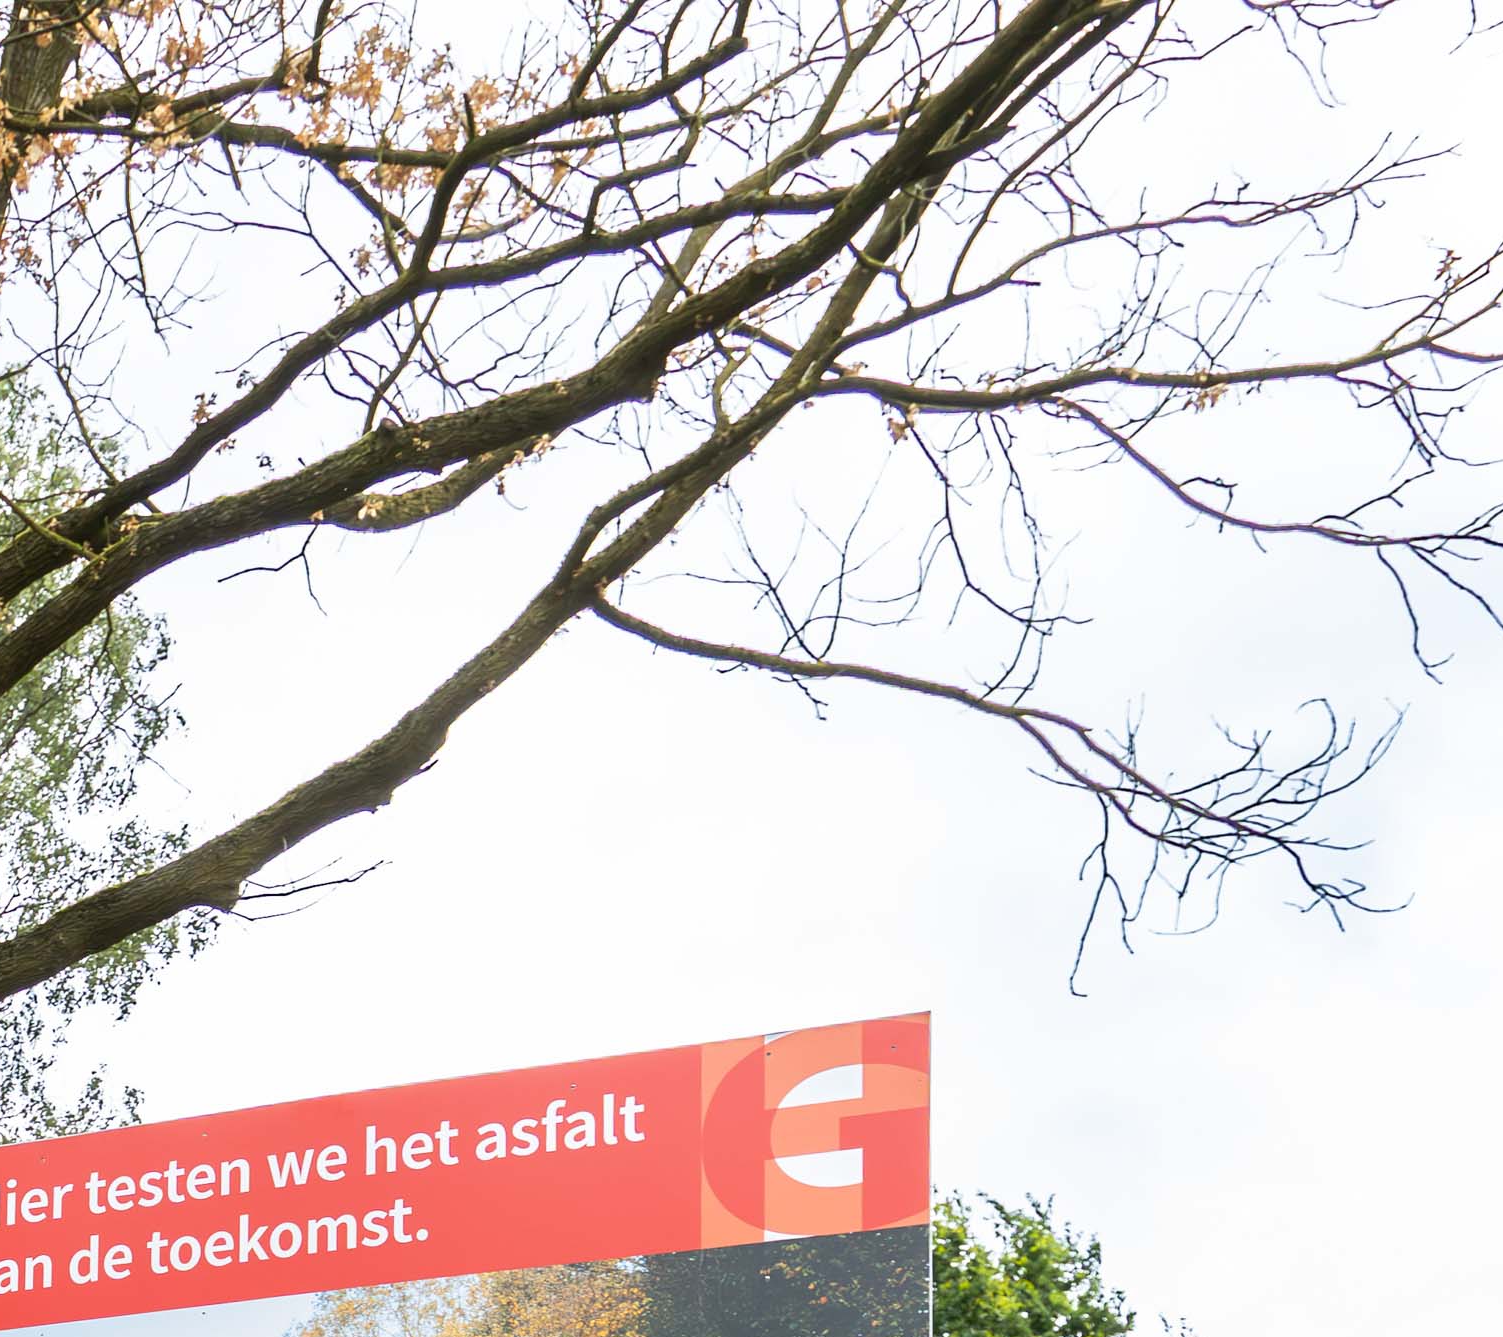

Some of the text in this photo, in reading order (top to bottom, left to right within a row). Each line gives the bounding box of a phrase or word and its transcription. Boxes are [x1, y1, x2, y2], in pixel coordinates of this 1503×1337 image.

[85, 1156, 251, 1214] testen
[267, 1142, 348, 1190] we
[363, 1118, 459, 1176] het
[474, 1093, 646, 1162] asfalt
[68, 1234, 133, 1286] de
[145, 1197, 430, 1276] toekomst.
